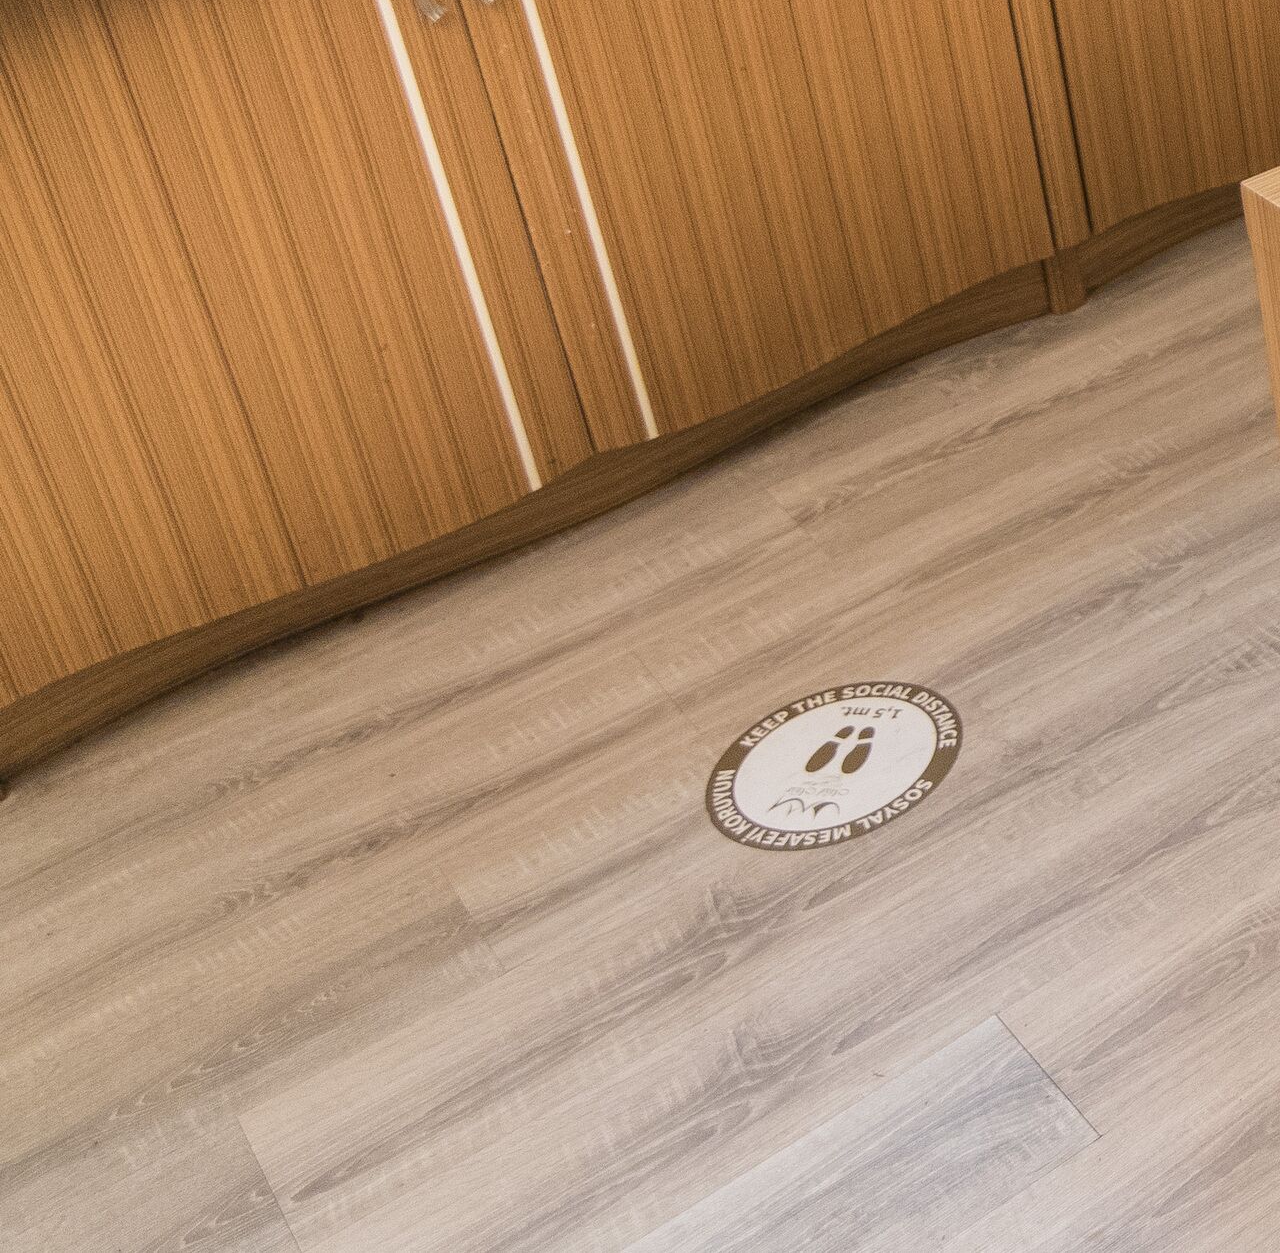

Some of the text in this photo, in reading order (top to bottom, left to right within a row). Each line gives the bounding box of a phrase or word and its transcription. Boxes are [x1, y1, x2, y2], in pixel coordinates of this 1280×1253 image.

[739, 683, 958, 749] KEEP THE SOCIAL DISTANCE
[872, 707, 904, 719] 1,5
[713, 769, 933, 847] SOSYAL MESAFEYİ KORUYUN
